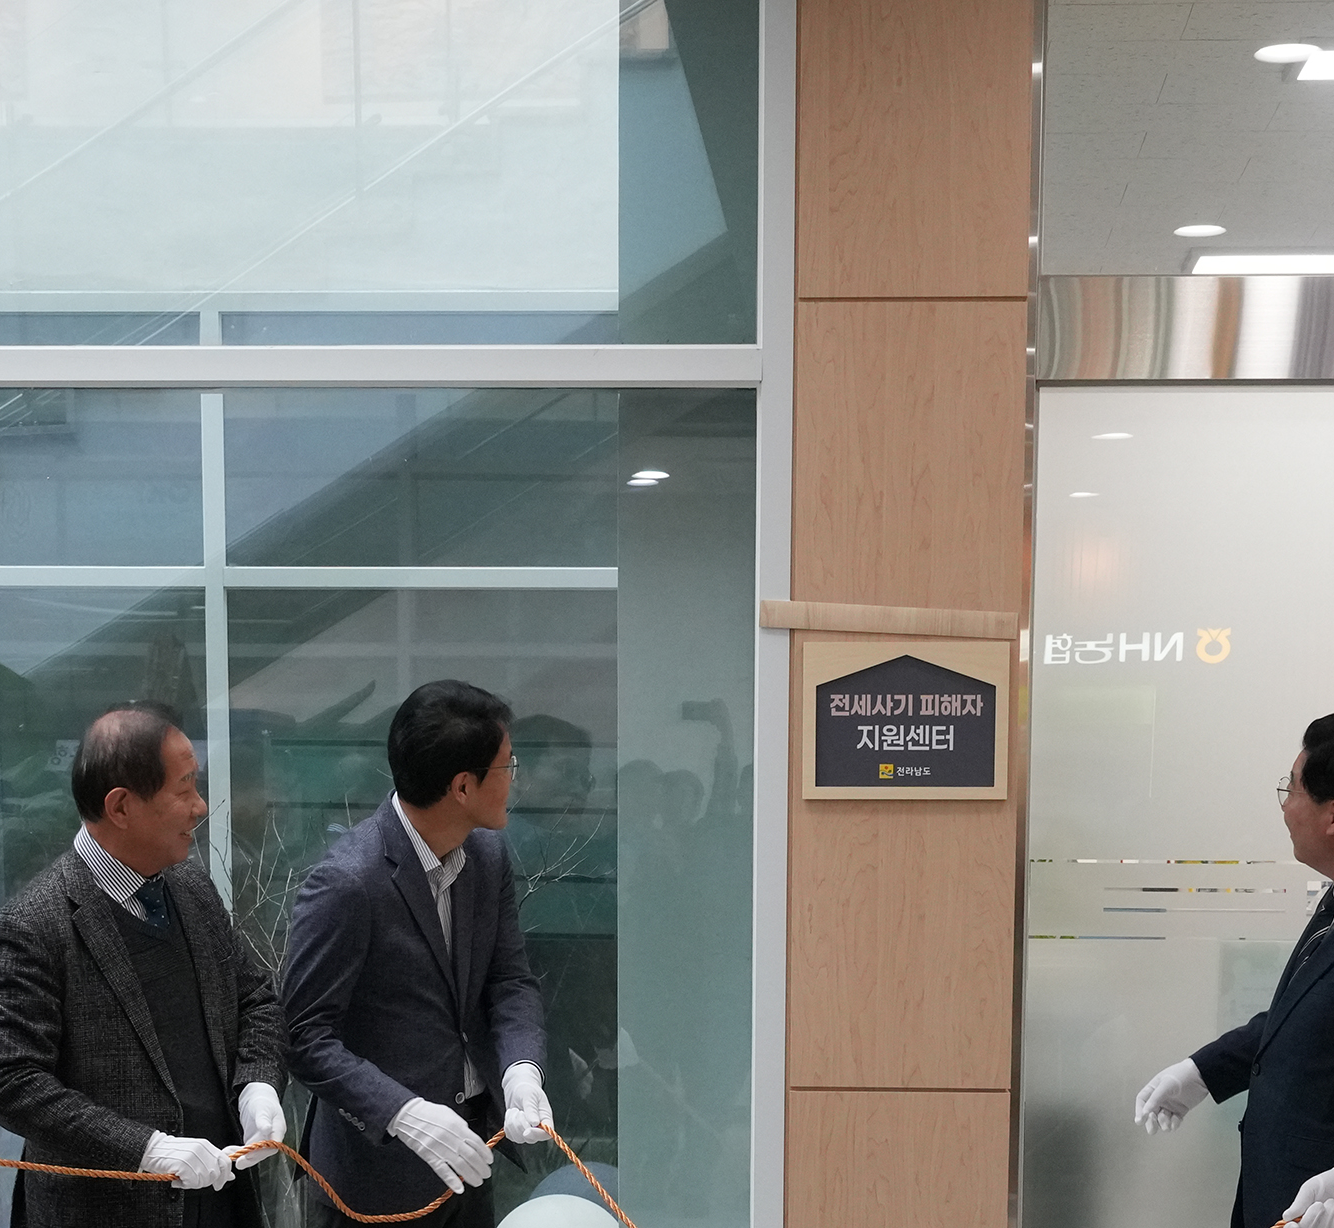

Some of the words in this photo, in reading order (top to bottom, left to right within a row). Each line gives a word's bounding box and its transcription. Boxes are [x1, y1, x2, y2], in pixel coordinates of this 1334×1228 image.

[829, 694, 914, 717] 전세사기
[919, 694, 984, 717] 피해자
[856, 725, 955, 751] 지원센터
[896, 766, 932, 777] 전라남도
